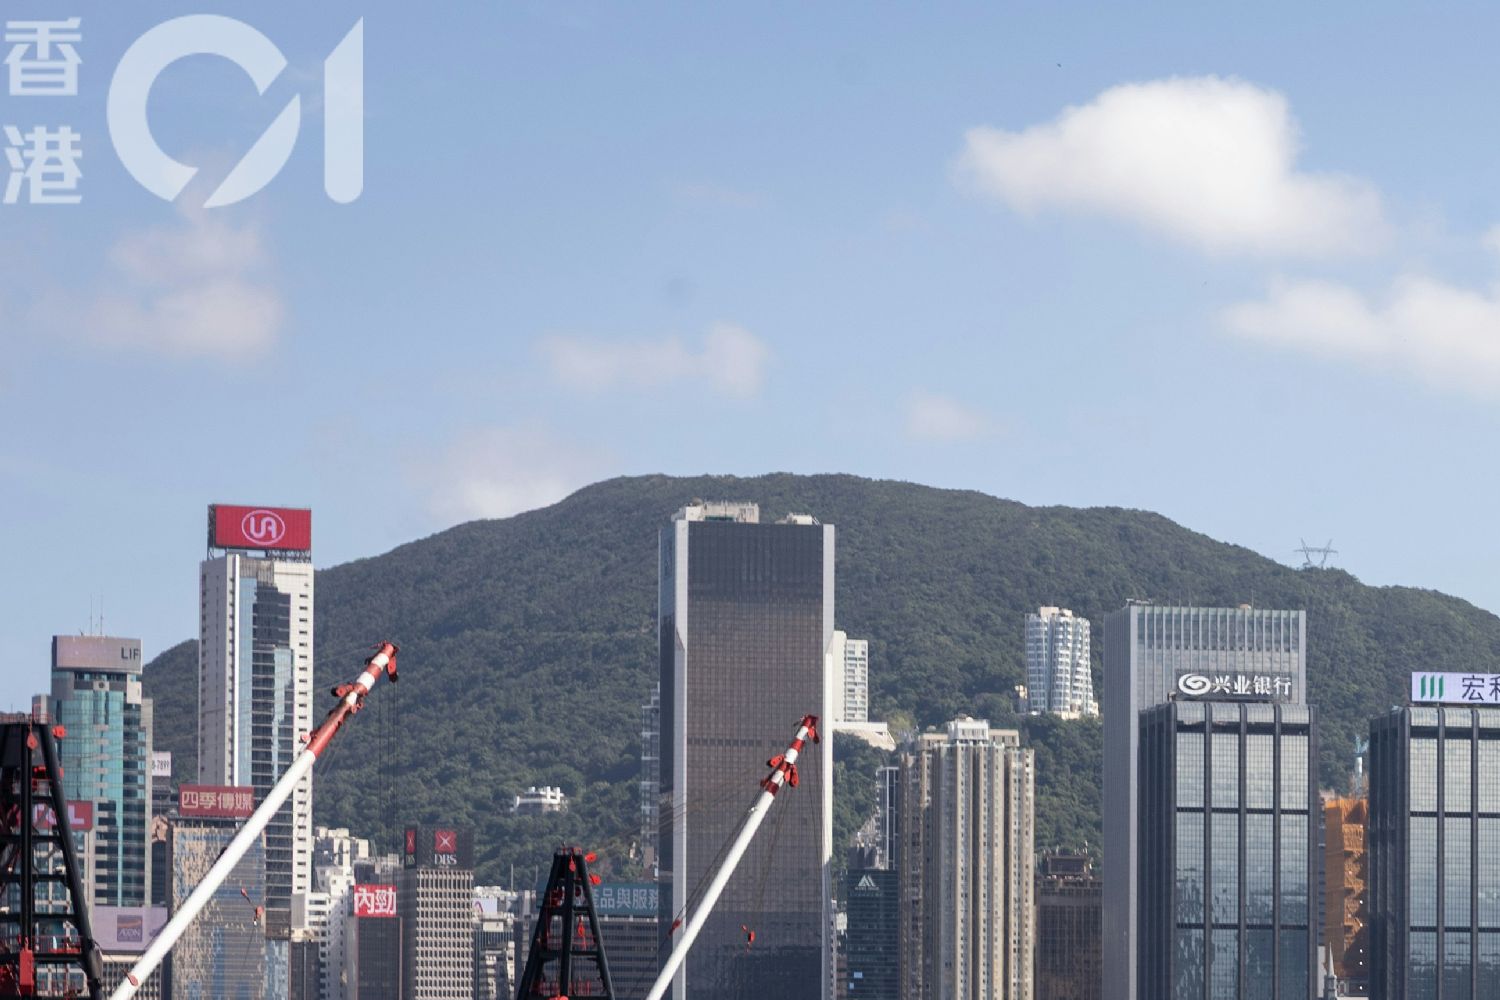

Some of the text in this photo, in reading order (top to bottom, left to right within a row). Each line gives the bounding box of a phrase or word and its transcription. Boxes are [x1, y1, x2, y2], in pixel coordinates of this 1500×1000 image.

[1211, 675, 1291, 695] 兴业银行
[182, 791, 253, 811] 四季傳媒
[434, 853, 458, 865] DBS
